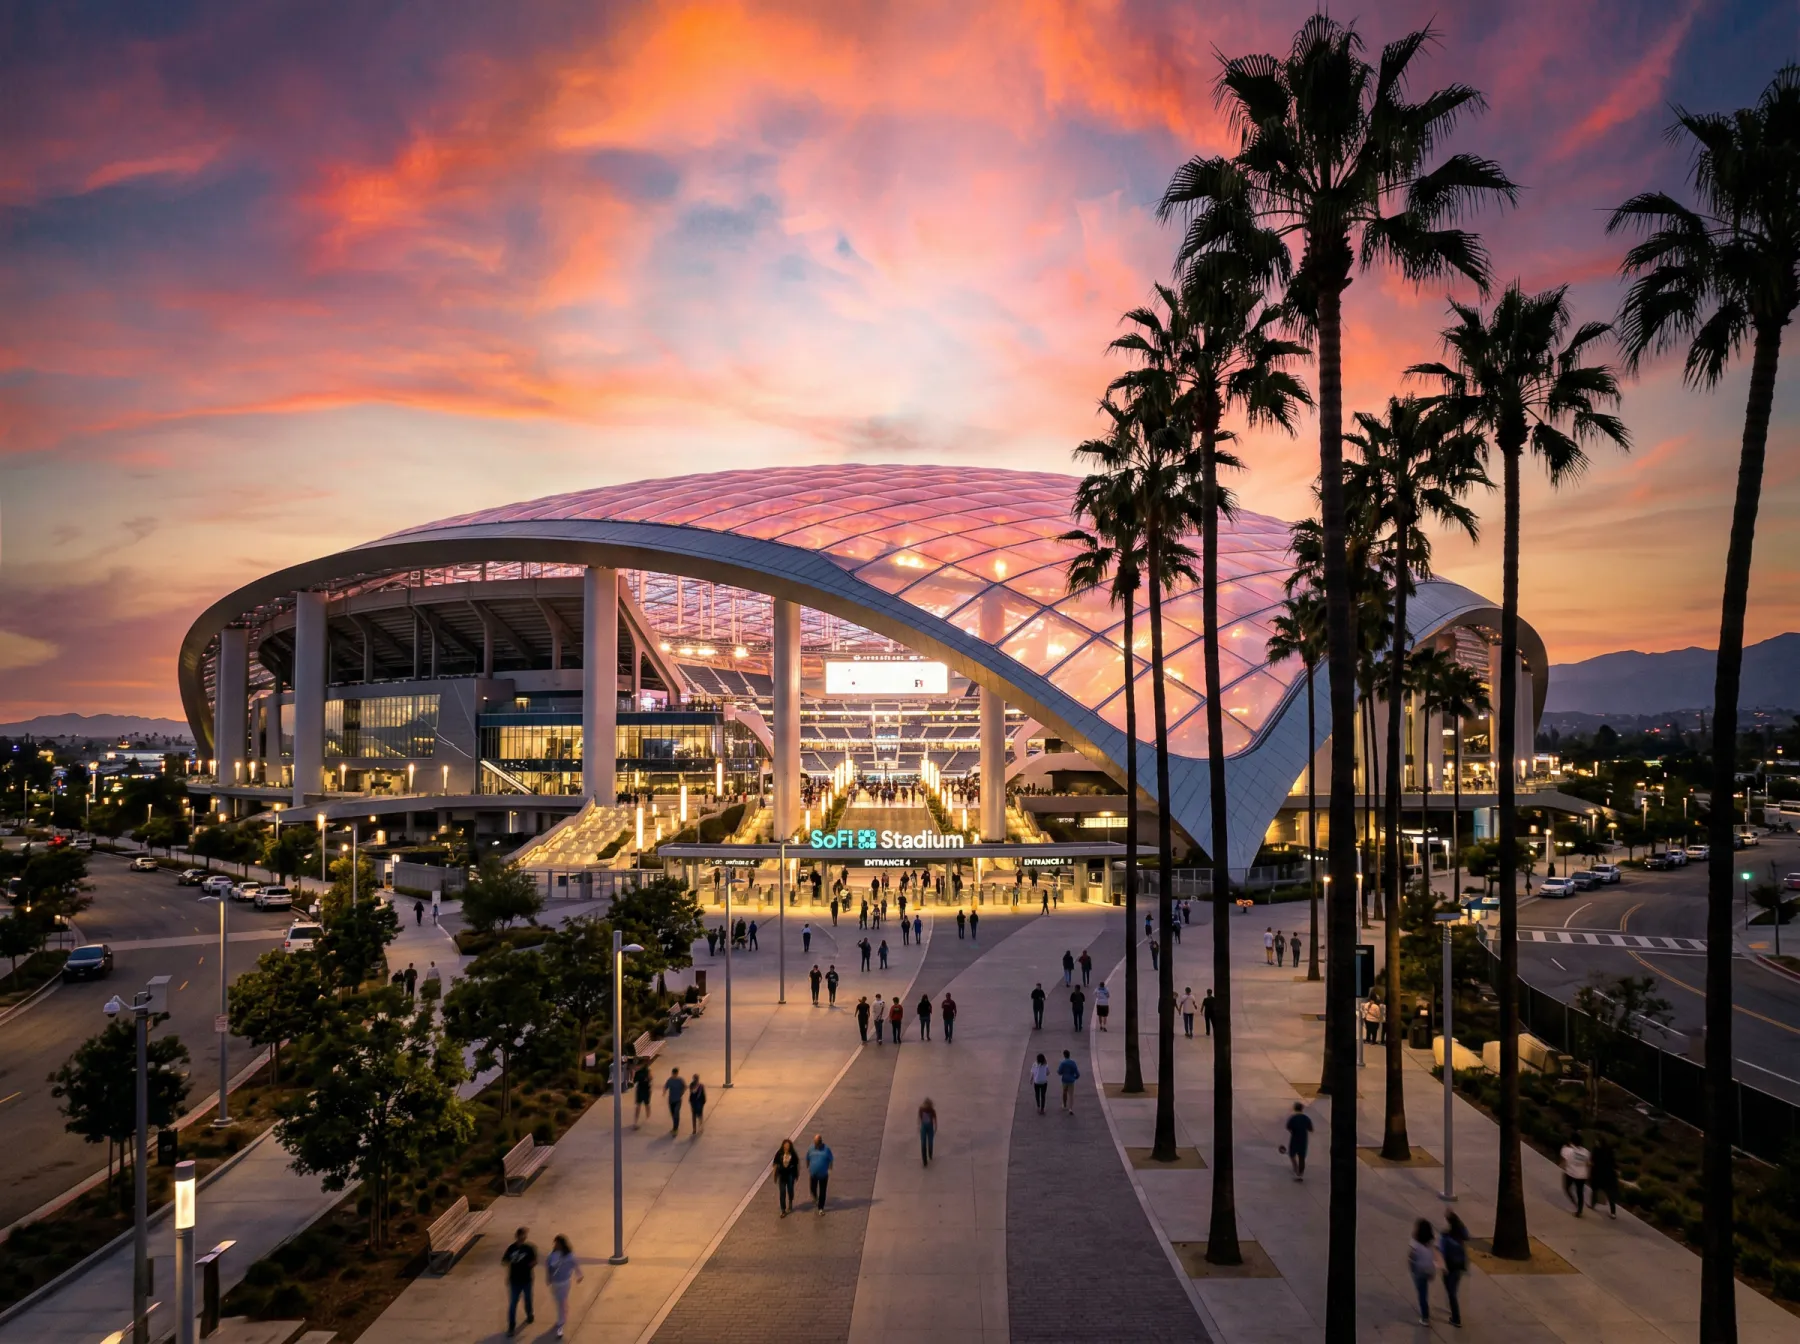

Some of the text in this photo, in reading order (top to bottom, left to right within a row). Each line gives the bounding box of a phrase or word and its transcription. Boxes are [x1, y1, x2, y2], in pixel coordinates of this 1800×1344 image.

[810, 829, 964, 849] SoFi Stadium
[864, 859, 911, 867] ENTRANCE 4
